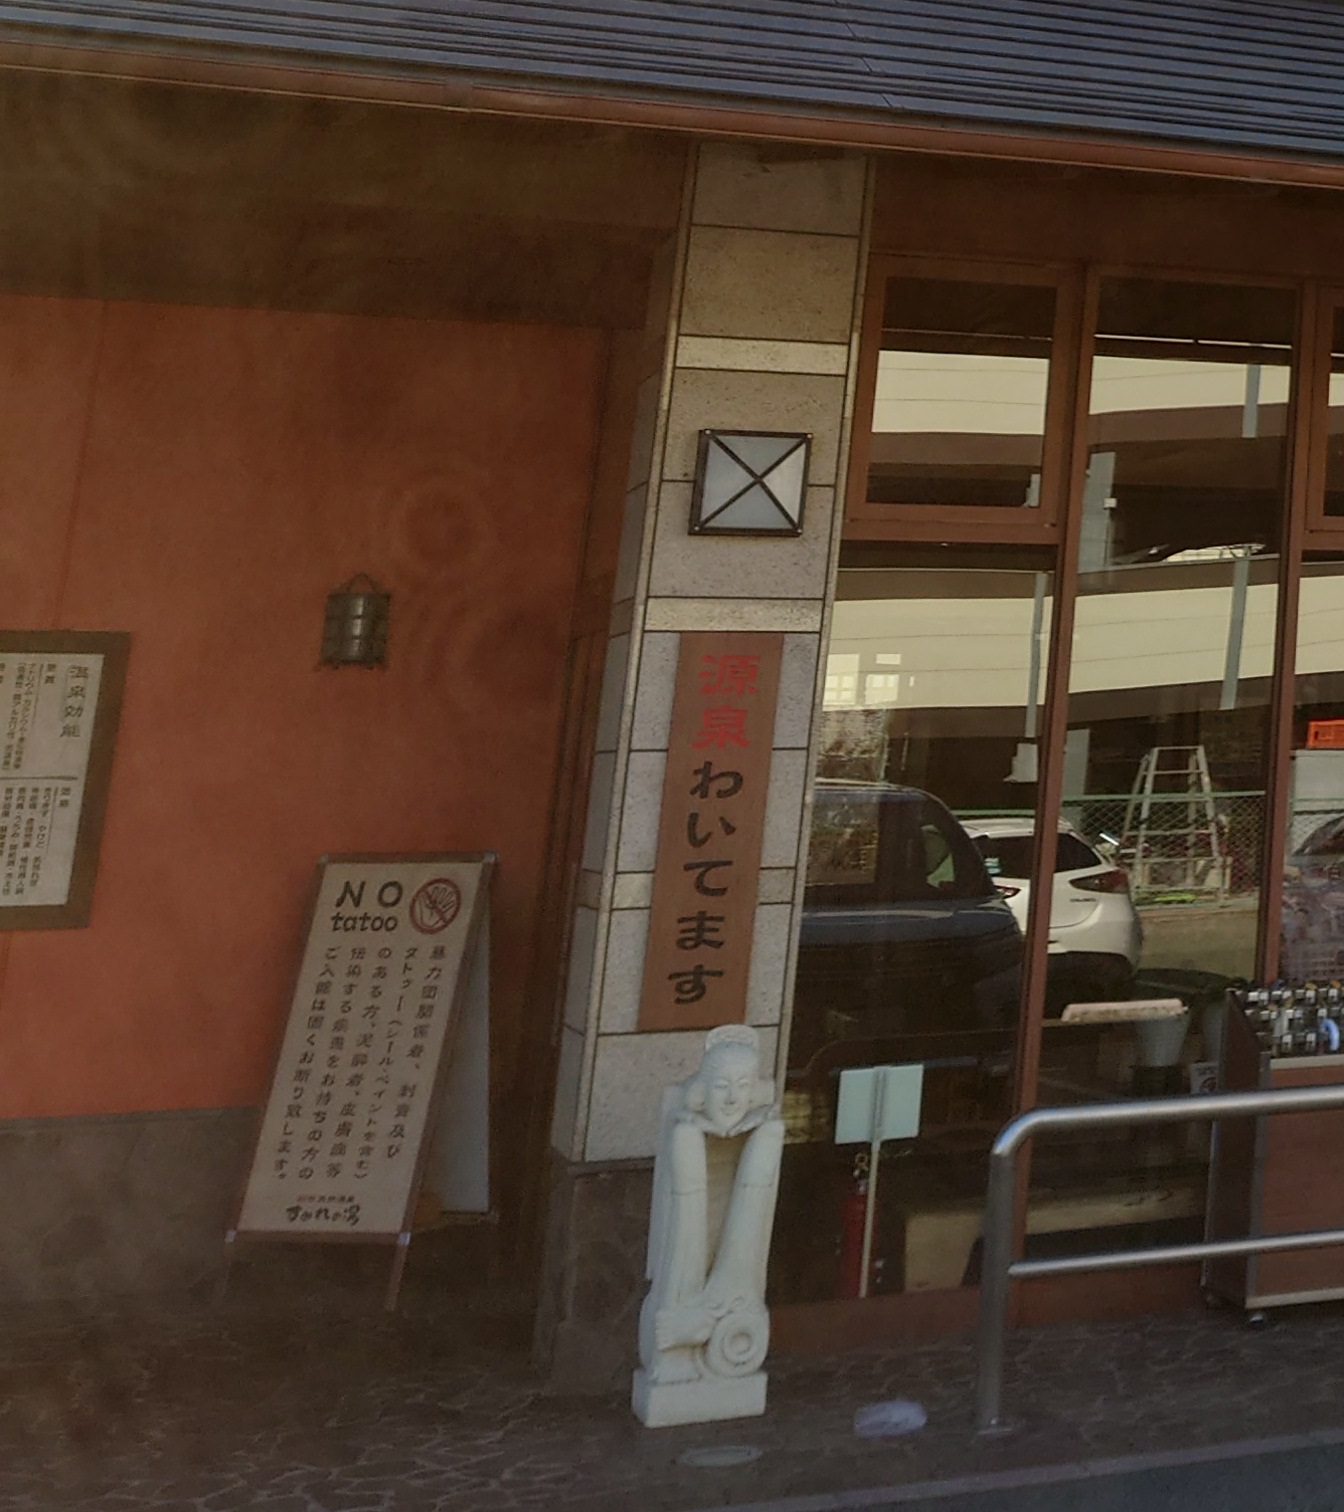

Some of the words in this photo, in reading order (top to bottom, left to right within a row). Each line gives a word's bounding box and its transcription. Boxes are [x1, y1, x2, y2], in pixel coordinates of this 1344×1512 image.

[668, 654, 761, 1005] 源泉わいてます
[335, 880, 403, 908] NO
[330, 912, 398, 932] tatoo
